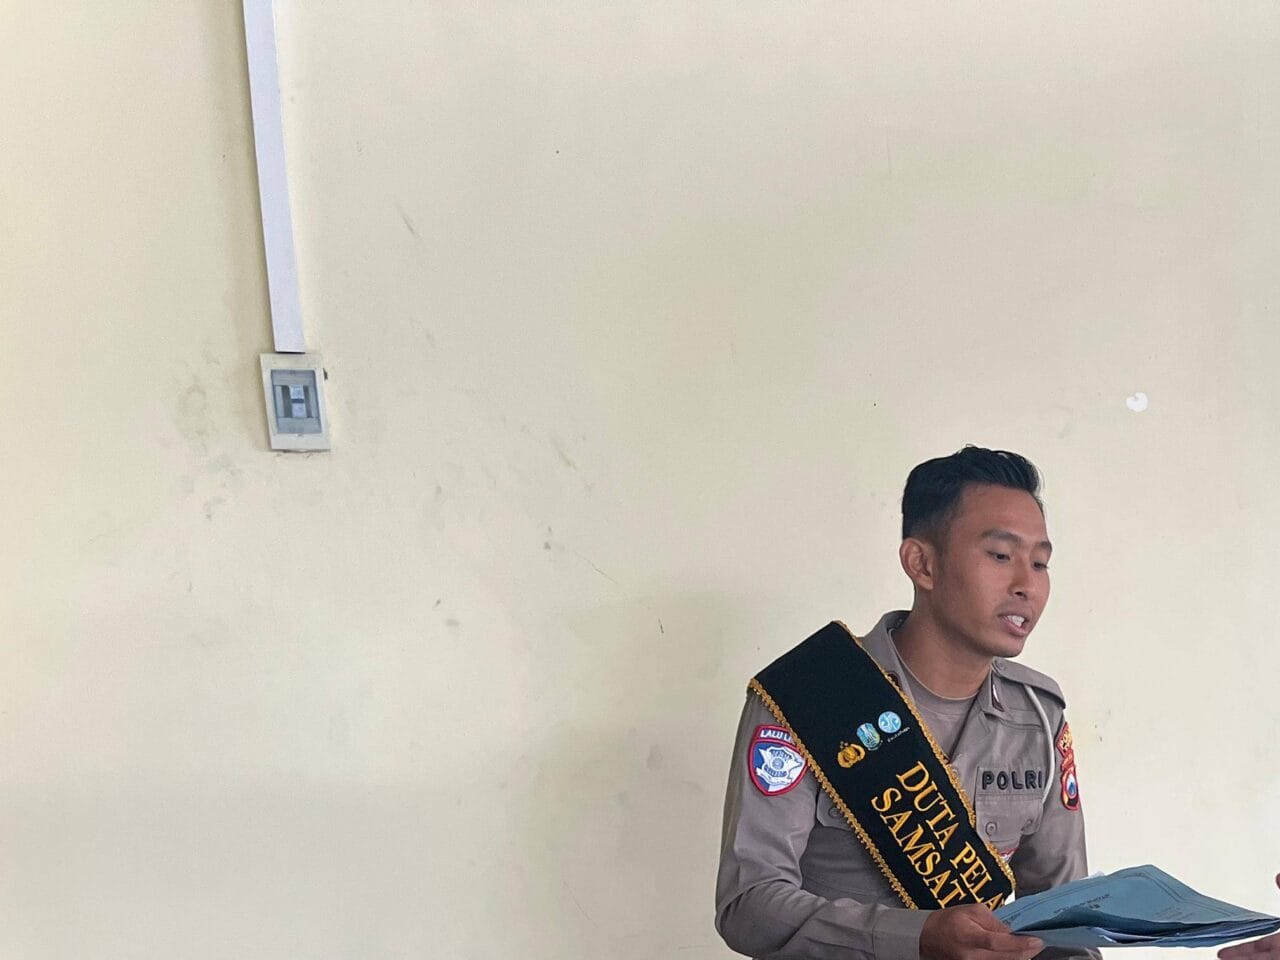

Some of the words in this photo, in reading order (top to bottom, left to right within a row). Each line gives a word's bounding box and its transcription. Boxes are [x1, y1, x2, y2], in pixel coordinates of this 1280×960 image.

[760, 729, 784, 740] LALU
[982, 770, 1042, 790] POLRI
[871, 787, 966, 909] SAMSAT
[896, 761, 959, 850] DUTA
[950, 841, 1005, 911] PELA
